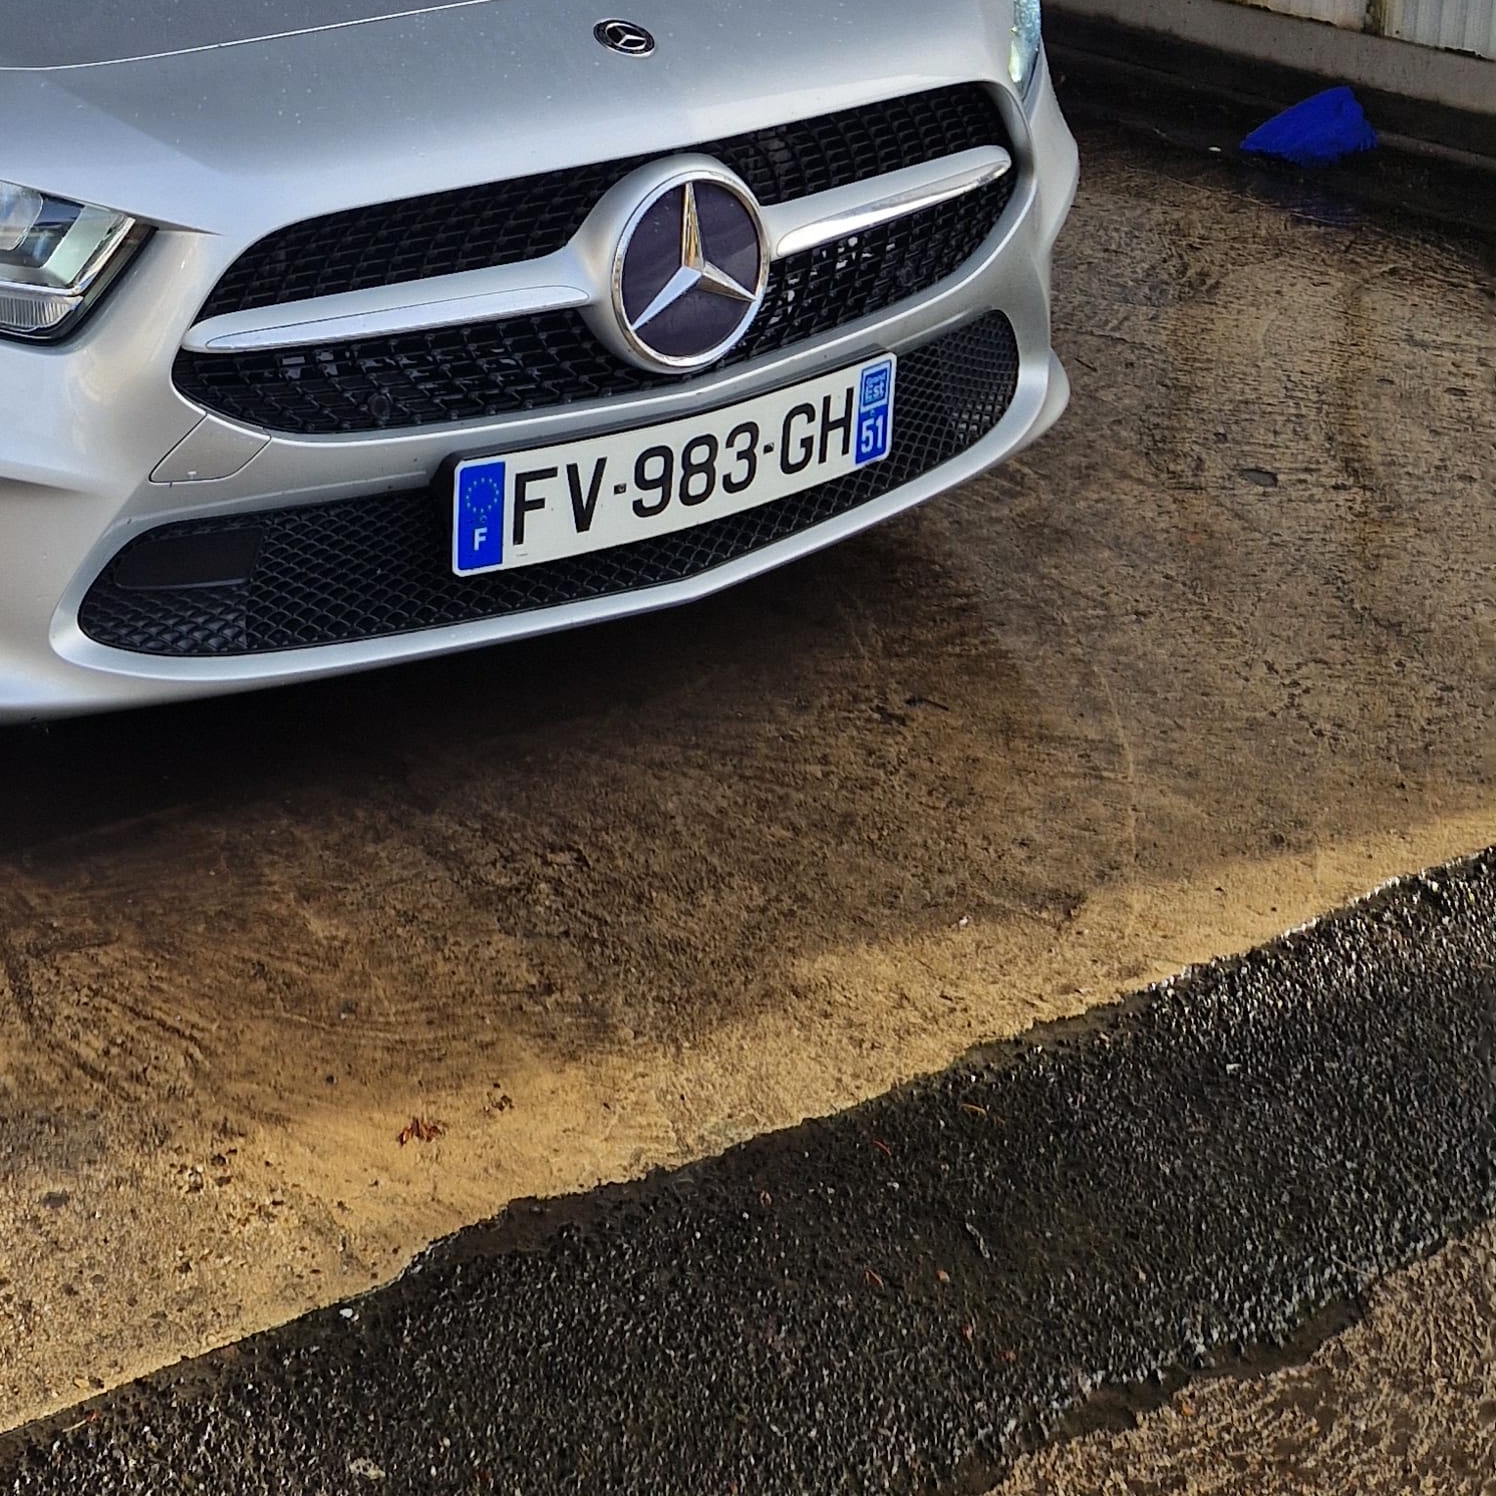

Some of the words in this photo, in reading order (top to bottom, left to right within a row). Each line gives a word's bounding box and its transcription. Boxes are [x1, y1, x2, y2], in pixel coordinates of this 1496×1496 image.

[473, 526, 488, 551] F
[512, 385, 855, 546] FV-983-GH
[861, 414, 884, 453] 51
